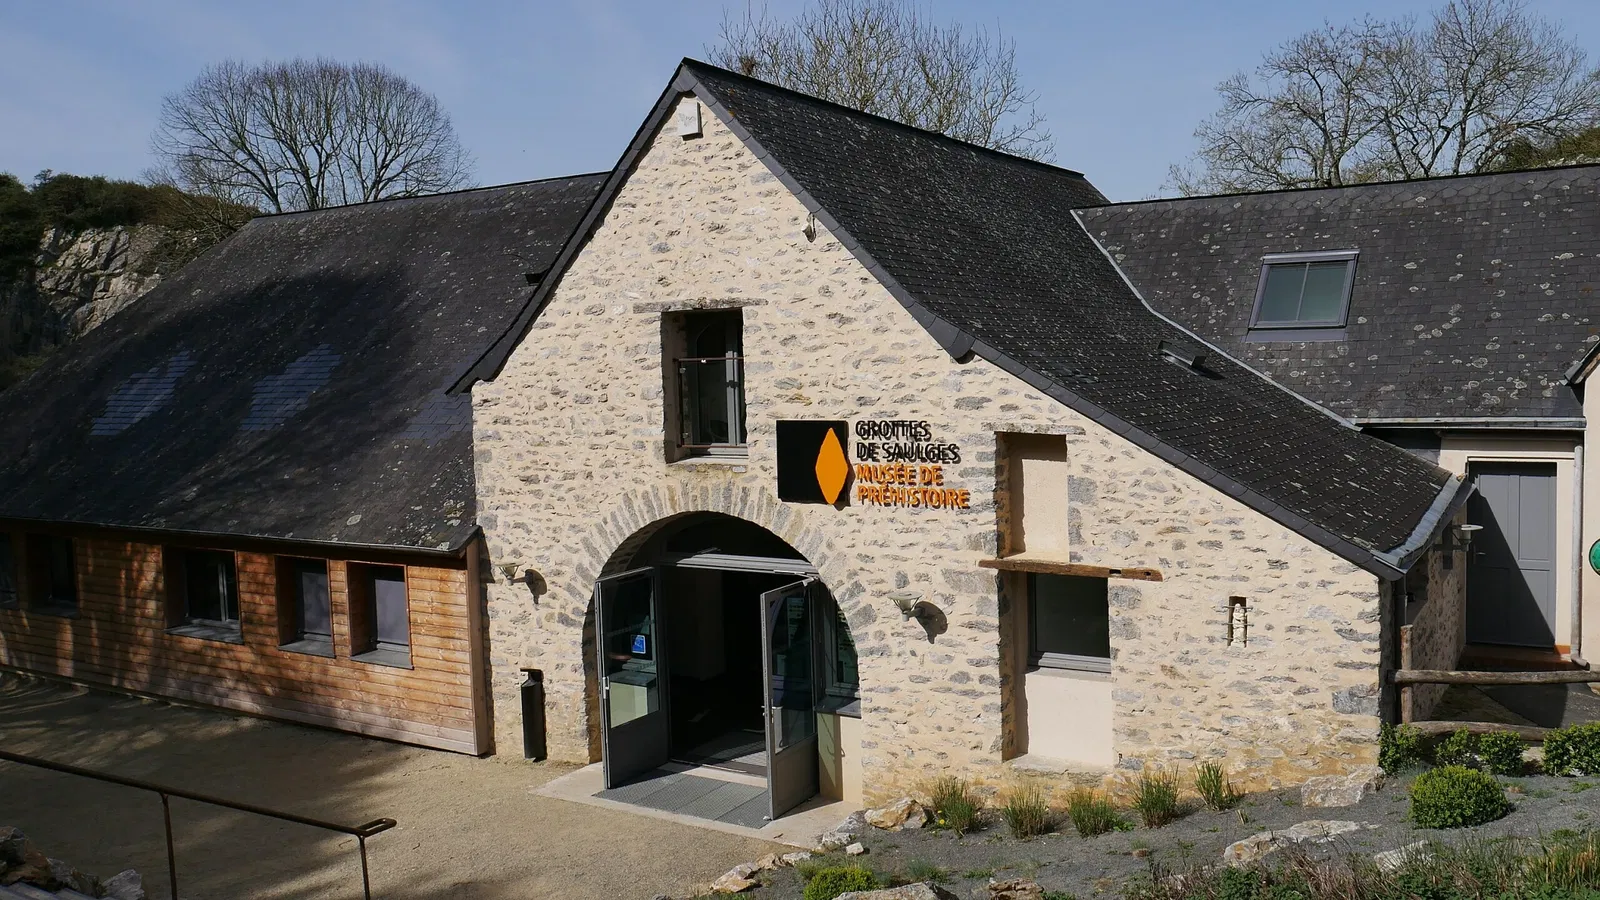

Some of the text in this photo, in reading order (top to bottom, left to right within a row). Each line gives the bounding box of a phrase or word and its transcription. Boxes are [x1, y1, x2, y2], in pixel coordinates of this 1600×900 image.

[855, 420, 930, 440] GROTTES
[856, 442, 960, 462] DE SAULGES
[856, 462, 943, 484] MUSÉE DE
[856, 484, 970, 508] PRÉHISTOIRE
